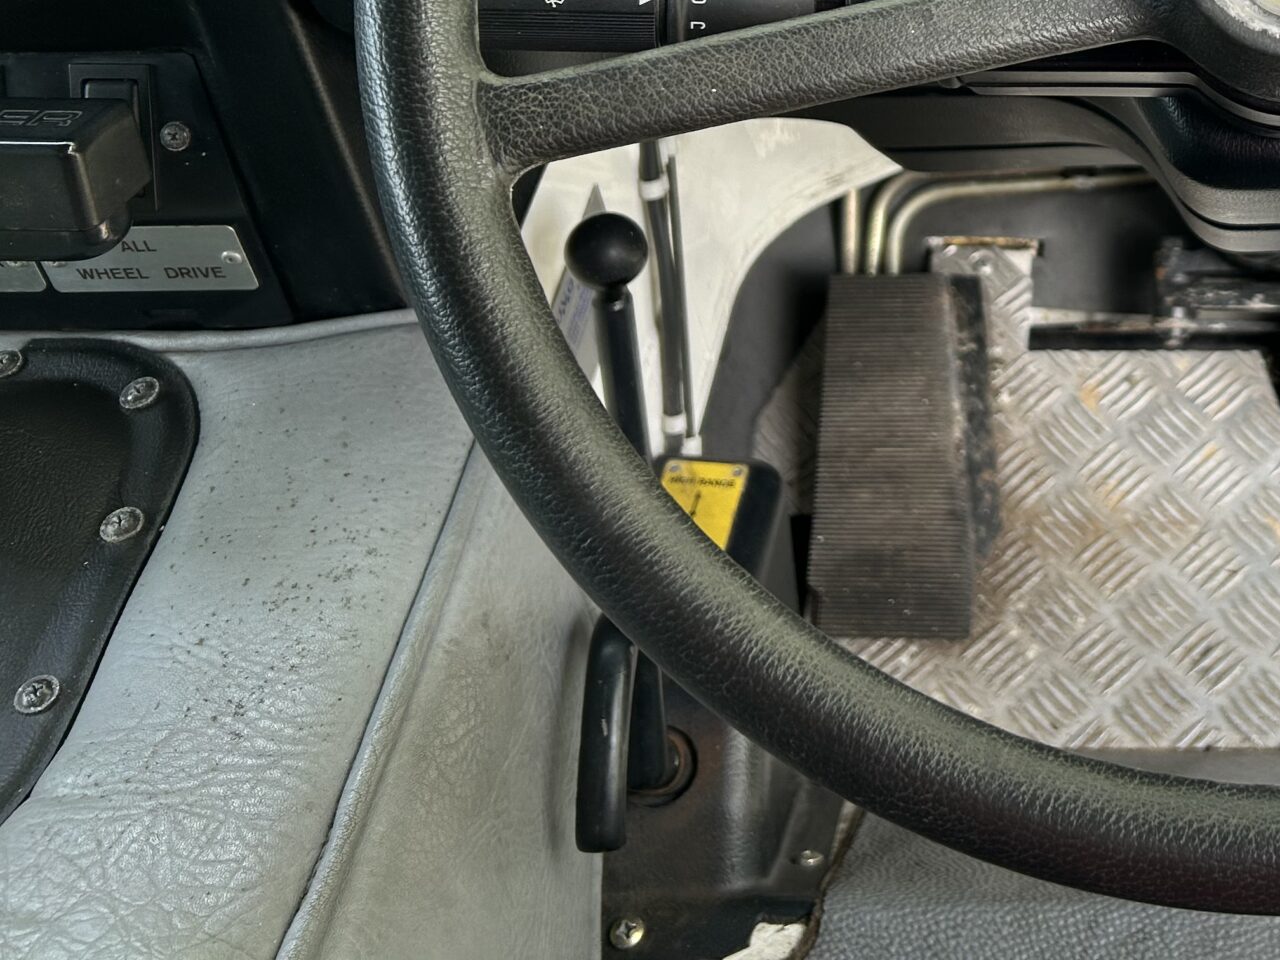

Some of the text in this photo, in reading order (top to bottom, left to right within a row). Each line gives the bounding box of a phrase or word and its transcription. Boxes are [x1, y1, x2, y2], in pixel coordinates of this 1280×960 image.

[121, 241, 157, 252] ALL
[77, 267, 226, 280] WHEEL DRIVE
